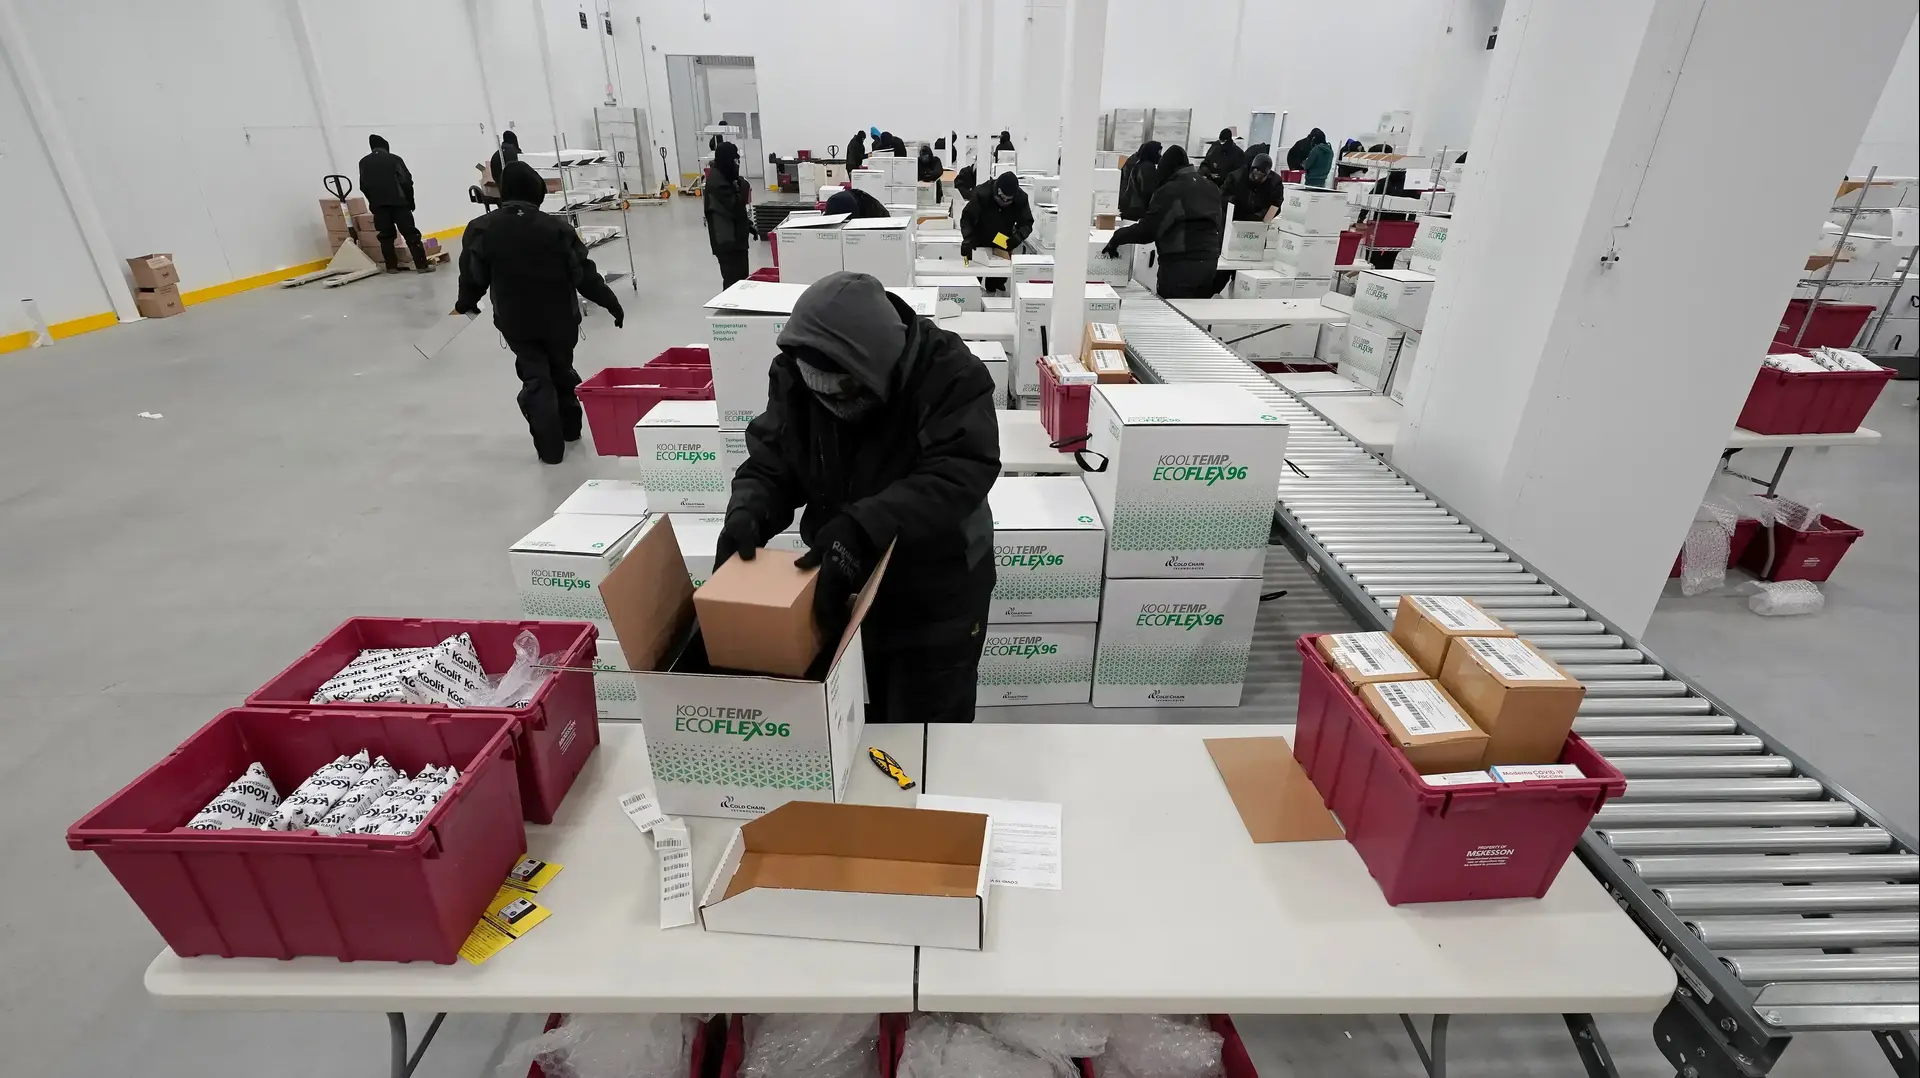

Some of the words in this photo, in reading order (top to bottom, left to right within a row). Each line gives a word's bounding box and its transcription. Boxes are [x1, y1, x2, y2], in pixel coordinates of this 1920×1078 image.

[656, 443, 702, 451] KOOLTEMP
[656, 451, 716, 464] ECOFLEX96
[1157, 454, 1230, 466] KOOLTEMP
[1152, 465, 1249, 487] ECOFLEX96
[993, 545, 1048, 555] OOLTEMP
[994, 554, 1065, 571] COFLEX96
[531, 569, 576, 578] KOOLTEMP
[531, 577, 591, 591] ECOFLEX96
[1140, 603, 1207, 614] KOOLTEMP
[1136, 613, 1225, 631] ECOFLEX96
[986, 636, 1043, 645] KOOLTEMP
[983, 644, 1058, 659] ECOFLEX96
[349, 656, 387, 668] Koolit
[452, 650, 478, 673] Koolit
[332, 669, 368, 680] oolit
[353, 672, 393, 685] Koolit
[434, 660, 462, 683] Koolit
[318, 682, 347, 692] oolit
[417, 670, 445, 693] Koolit
[333, 685, 373, 701] Koolit
[447, 688, 466, 705] Koo
[676, 704, 763, 720] KOOLTEMP
[675, 717, 791, 742] ECOFLEX96
[230, 784, 269, 802] Koolit
[201, 803, 245, 820] Koolit
[247, 811, 267, 827] olit
